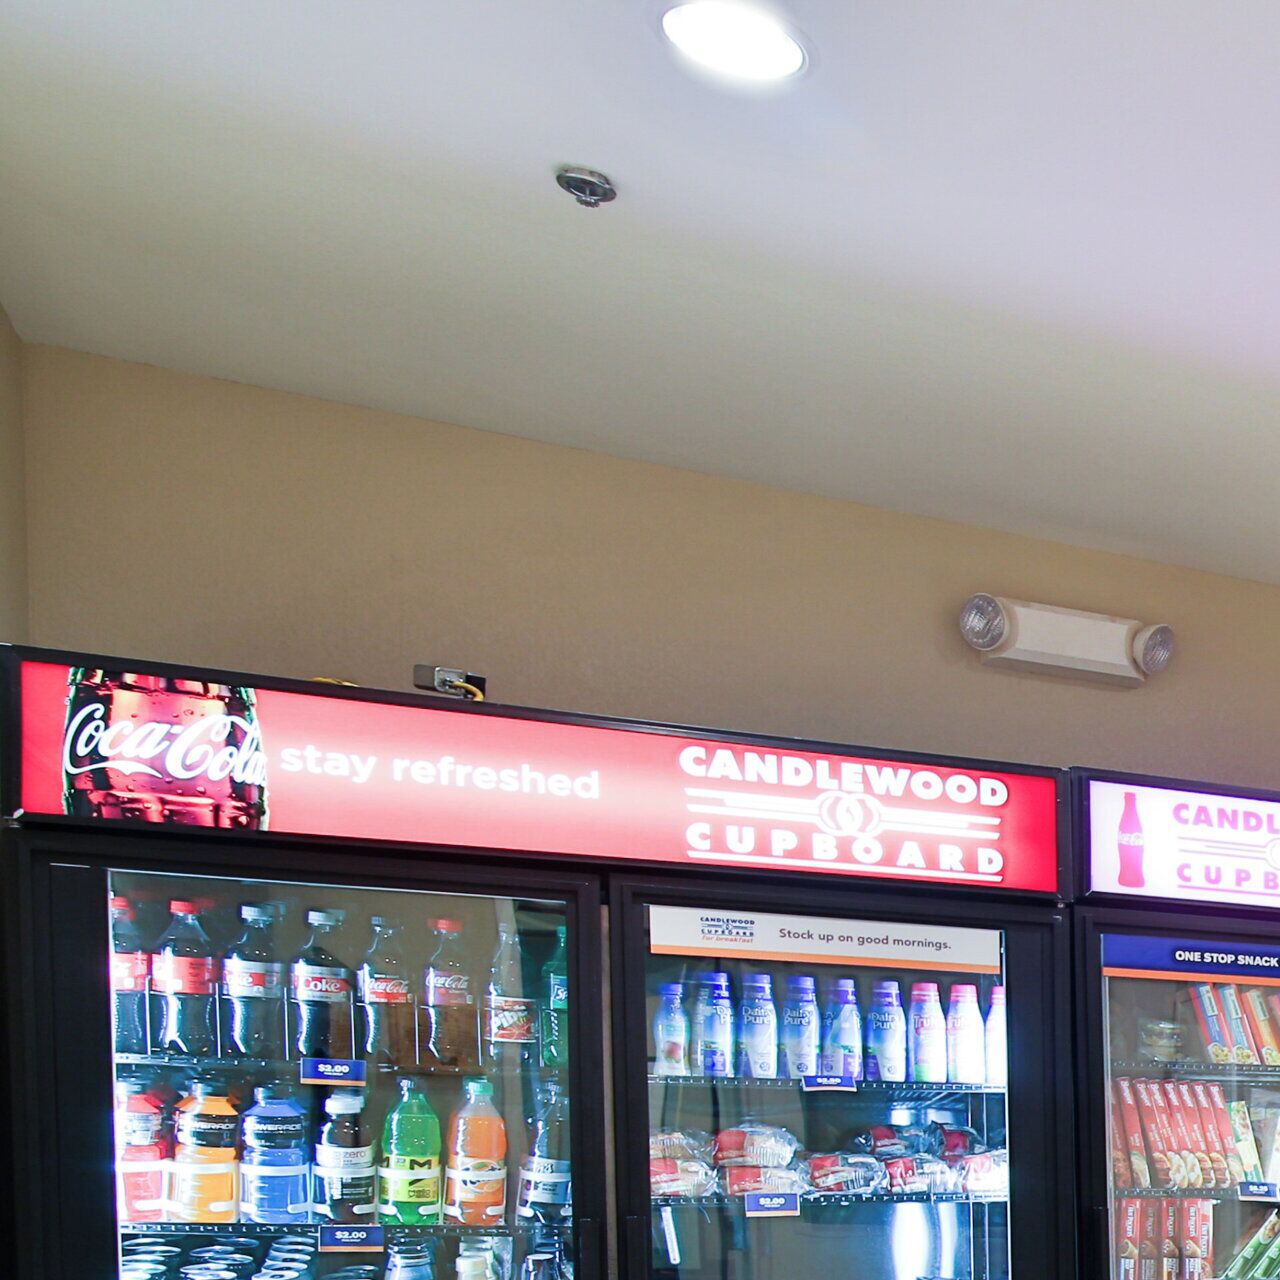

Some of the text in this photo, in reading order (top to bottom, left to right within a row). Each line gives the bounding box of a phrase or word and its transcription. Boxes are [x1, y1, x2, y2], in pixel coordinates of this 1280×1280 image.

[62, 702, 266, 788] Coca-Cola
[280, 744, 600, 800] stay refreshed
[678, 744, 1008, 808] CANDLEWOOD
[686, 822, 1004, 874] CUPBOARD
[700, 916, 756, 926] CANDLEWOOD
[700, 928, 754, 938] CUPBOARD
[778, 928, 952, 952] Stock up on good mornings.
[1174, 950, 1202, 963] ONE
[1202, 952, 1236, 965] STOP
[1236, 954, 1280, 968] SNACK
[303, 976, 340, 992] Coke
[742, 1006, 772, 1017] Dairy
[782, 1008, 812, 1018] Dairy
[744, 1014, 771, 1025] Pure
[784, 1016, 811, 1026] Pure
[318, 1063, 350, 1074] $2.00
[342, 1150, 367, 1160] zero
[334, 1230, 367, 1240] $2.00
